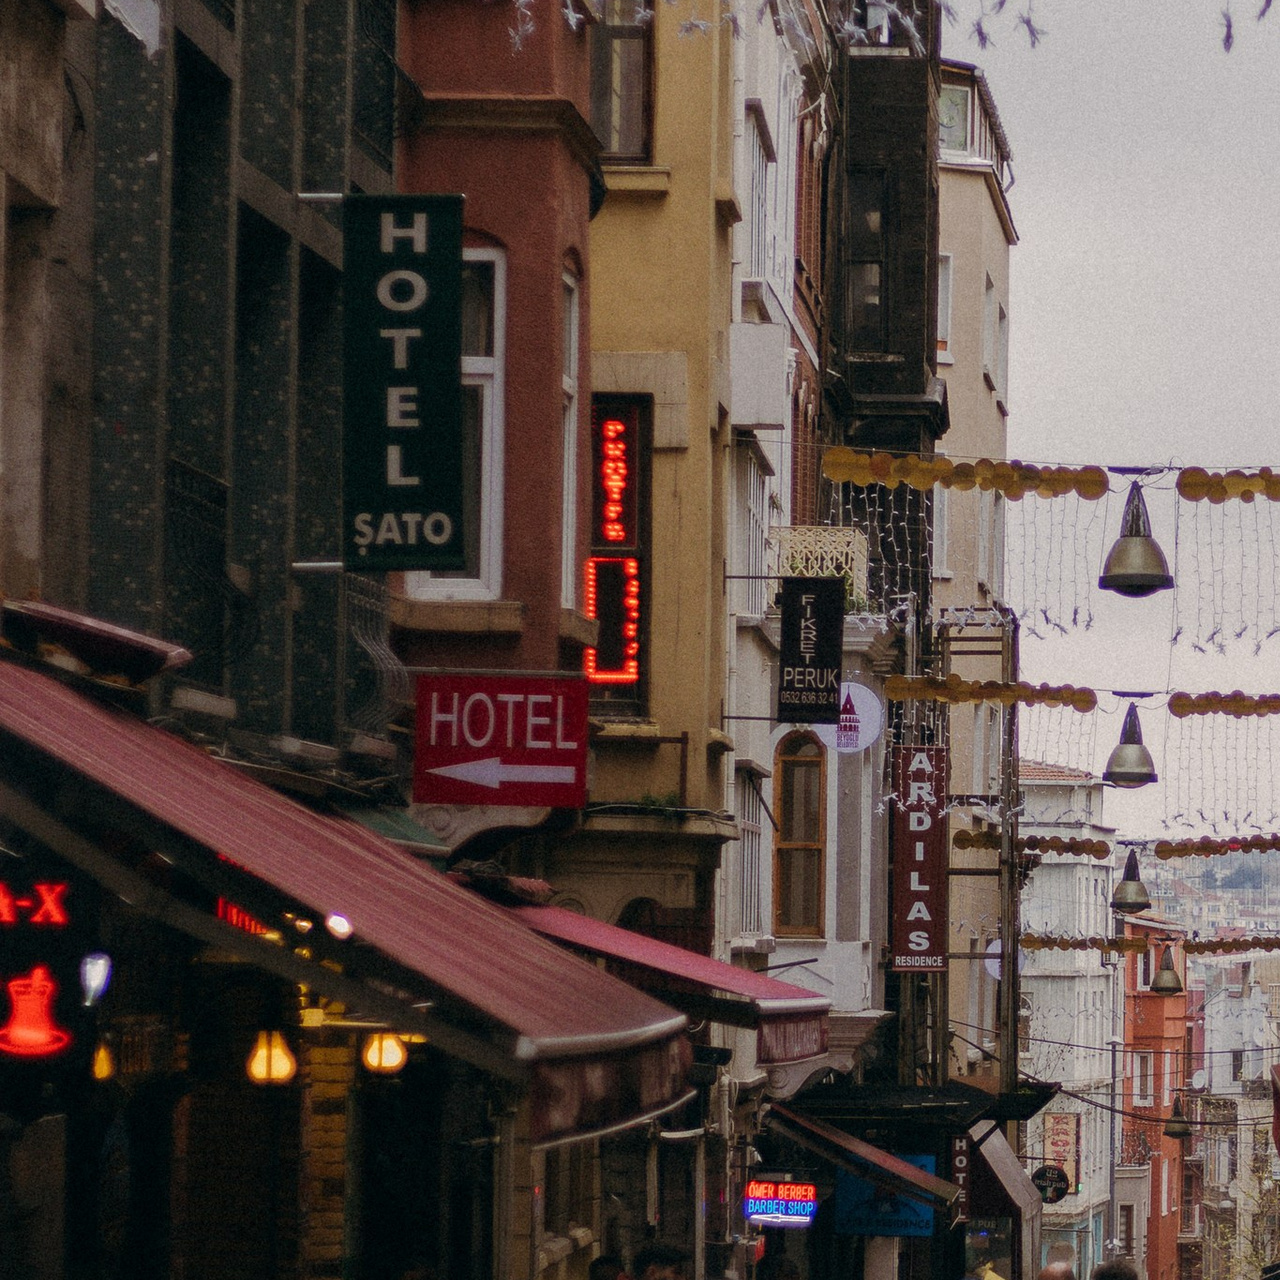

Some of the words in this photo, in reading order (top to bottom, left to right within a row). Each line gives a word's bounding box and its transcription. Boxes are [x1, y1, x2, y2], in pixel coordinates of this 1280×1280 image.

[376, 212, 428, 486] HOTEL
[353, 511, 452, 556] ŞATO
[801, 594, 817, 665] FIKRET
[783, 667, 838, 689] PERUK
[781, 690, 800, 703] 0532
[801, 691, 816, 704] 636
[817, 692, 828, 704] 32
[829, 692, 838, 704] 41
[430, 691, 578, 750] HOTEL
[906, 752, 934, 951] ARDILAS
[895, 956, 943, 967] RESIDENCE
[748, 1199, 785, 1214] BARBER
[788, 1202, 814, 1215] SHOP
[778, 1184, 814, 1200] BERBER
